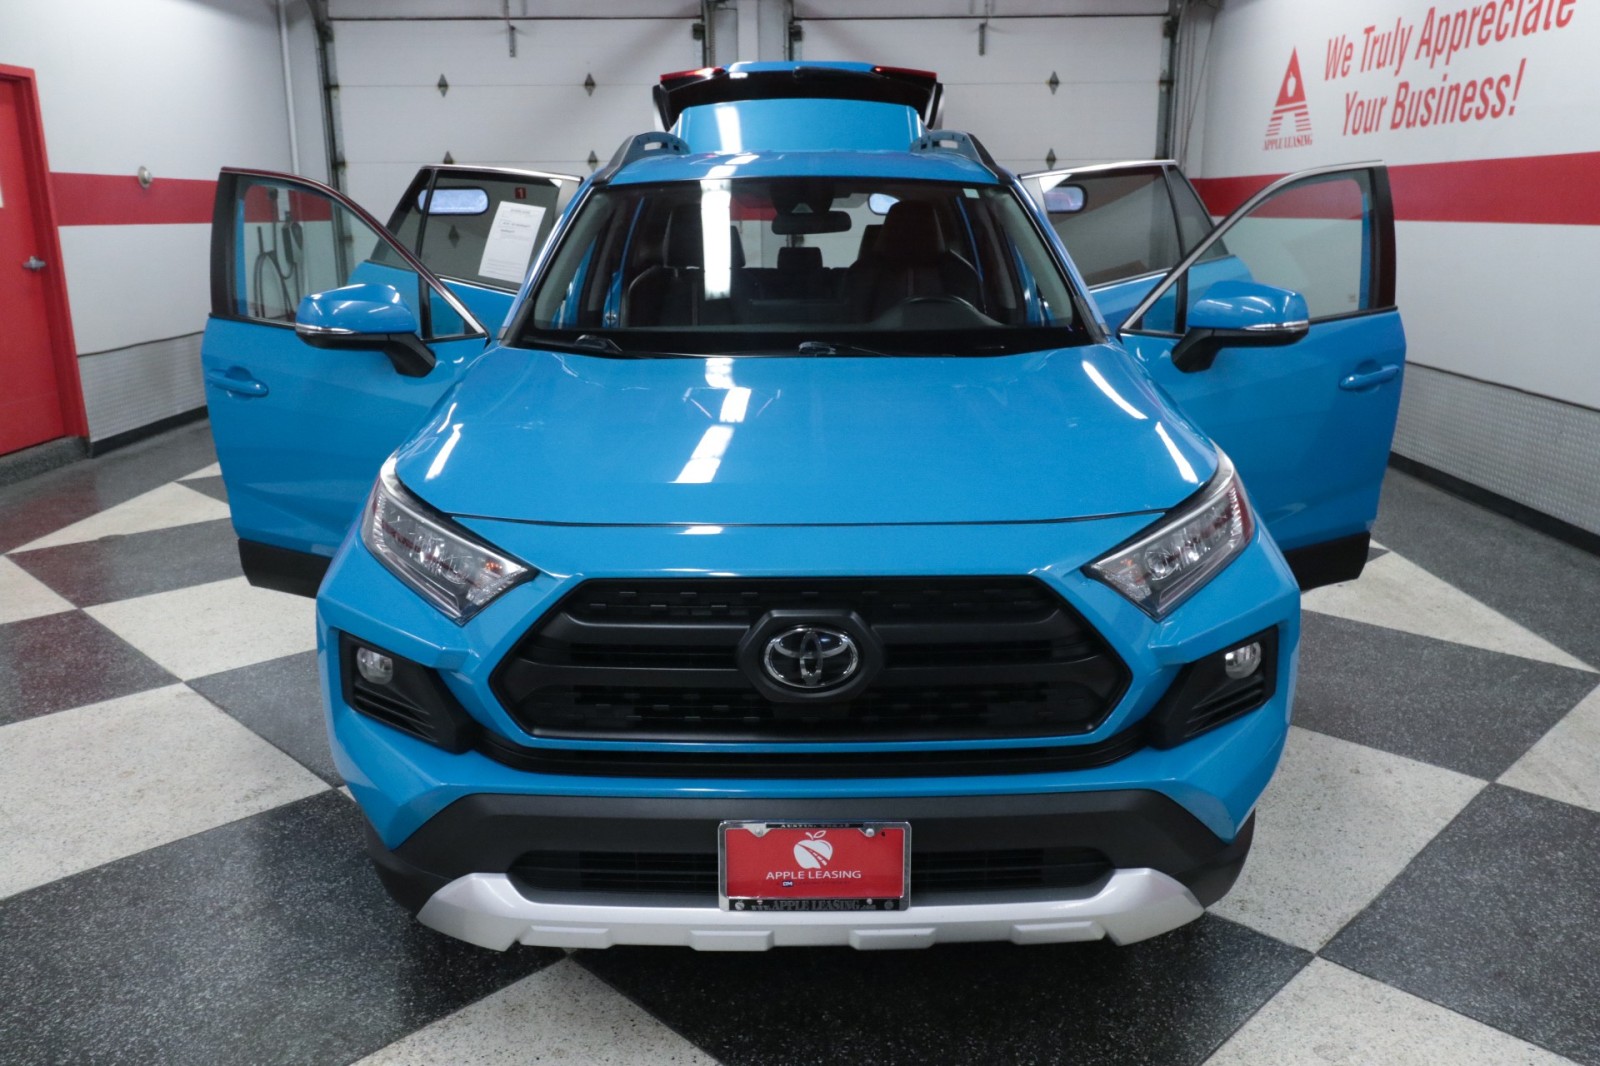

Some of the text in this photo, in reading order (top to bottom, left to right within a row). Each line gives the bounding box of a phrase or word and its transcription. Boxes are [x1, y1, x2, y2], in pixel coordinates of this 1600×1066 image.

[1324, 0, 1577, 81] We Truly Appreciate
[1342, 57, 1527, 136] Your Business!
[1263, 134, 1313, 151] APPLE LEASING
[766, 870, 862, 880] APPLE LEASING
